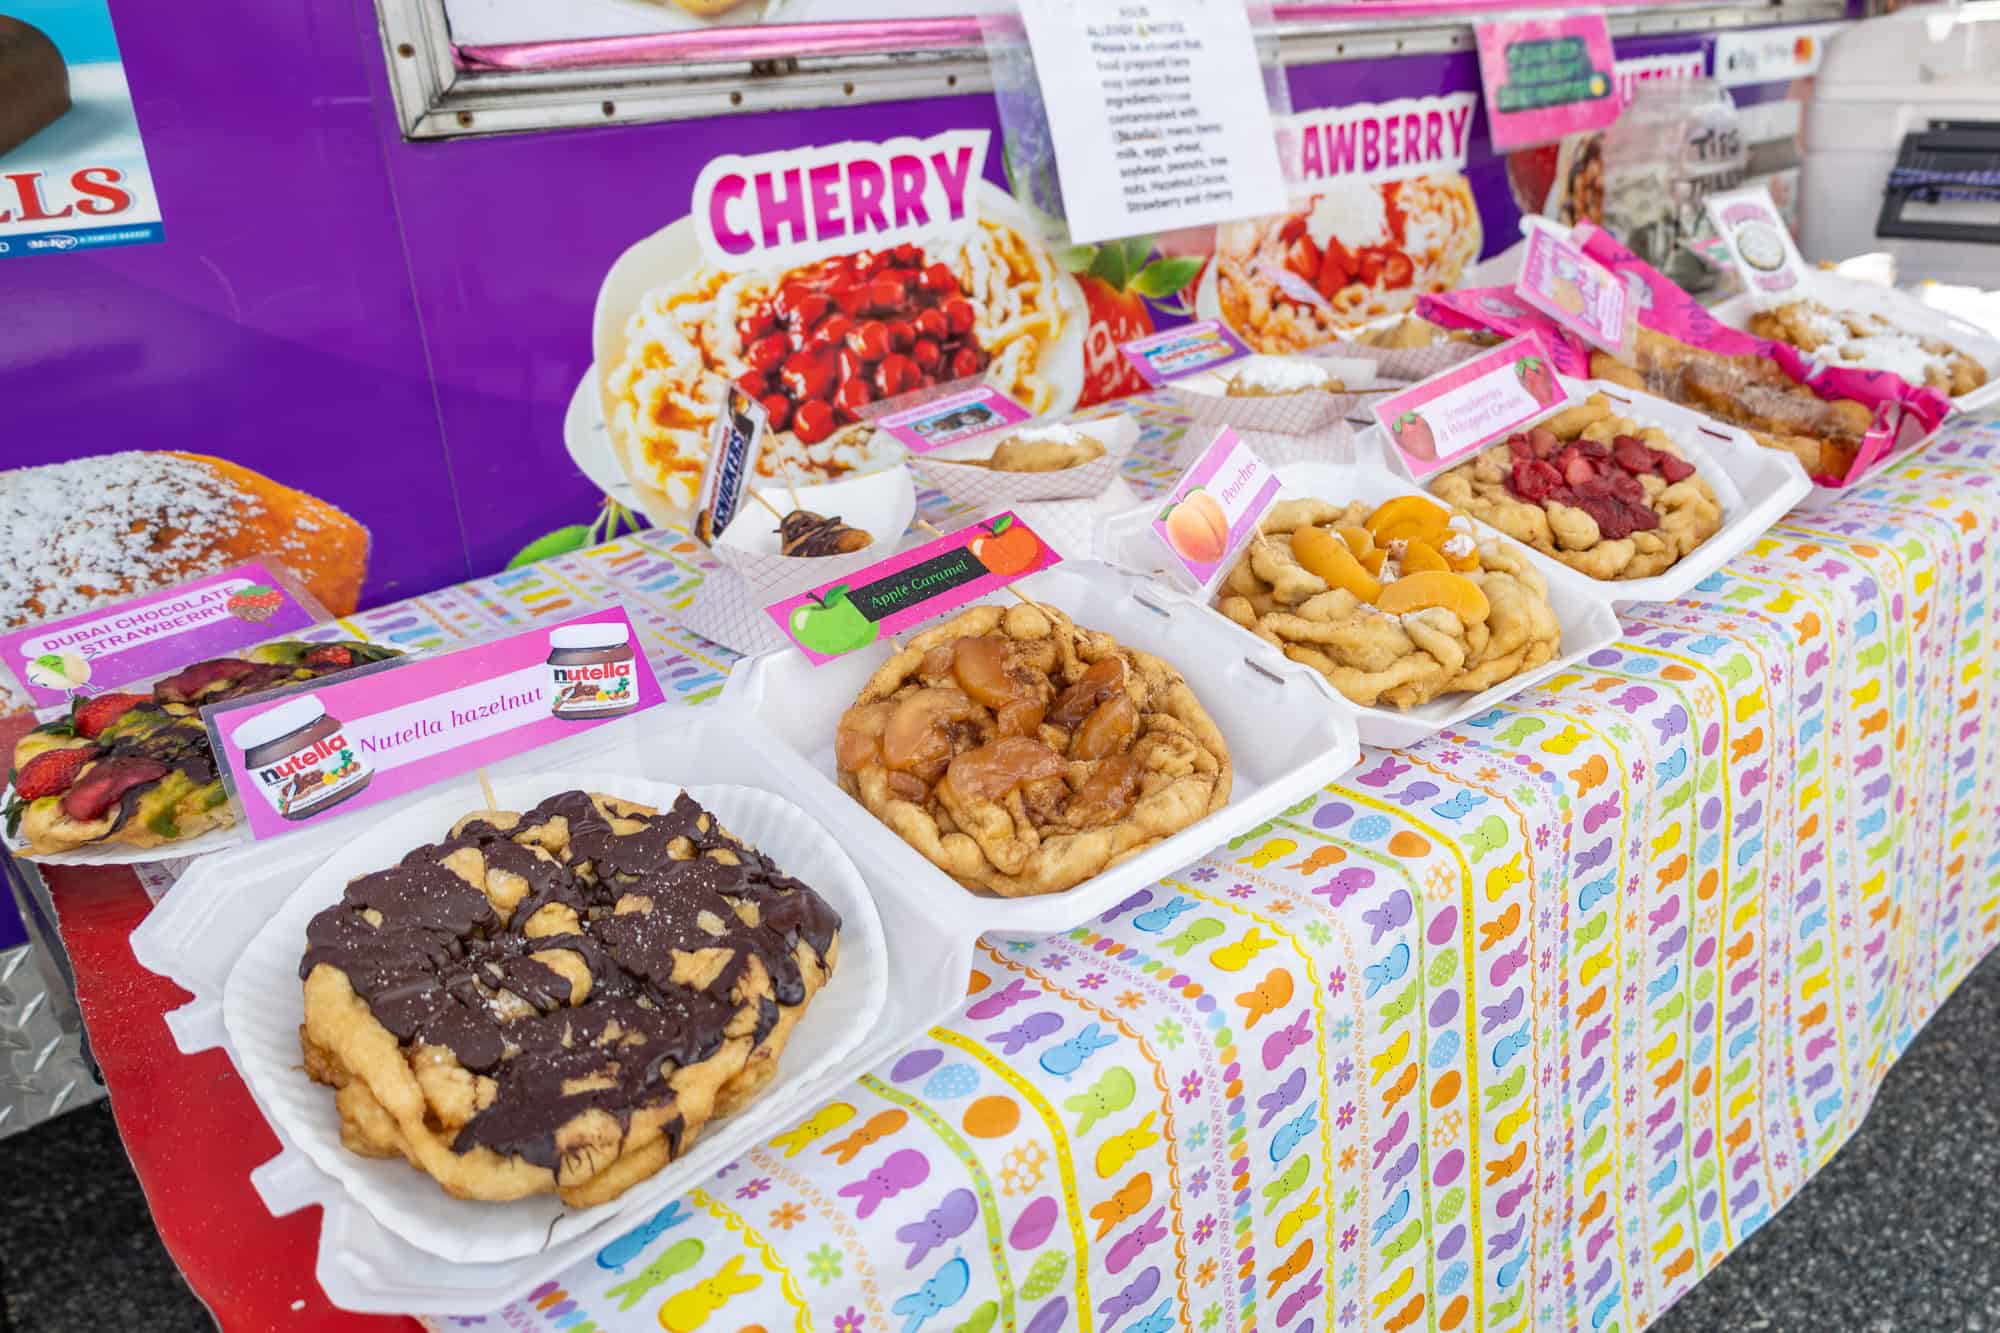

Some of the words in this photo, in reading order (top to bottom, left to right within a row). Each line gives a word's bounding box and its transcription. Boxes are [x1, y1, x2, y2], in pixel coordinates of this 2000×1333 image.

[1102, 80, 1123, 91] may
[1126, 76, 1161, 87] contain
[1164, 74, 1191, 85] these
[1124, 57, 1166, 71] prepared
[1109, 110, 1177, 125] contaminated
[1278, 105, 1469, 182] AWBERRY
[0, 167, 130, 223] LS
[709, 146, 974, 256] CHERRY
[1126, 198, 1181, 214] Strawberry
[1184, 194, 1201, 206] and
[1221, 461, 1257, 505] Peaches
[871, 580, 910, 609] Apple
[911, 558, 969, 591] Caramel
[42, 623, 114, 652] DUBAI
[114, 585, 236, 631] CHOCOLATE
[79, 601, 228, 655] STRAWBERRY
[554, 661, 631, 683] nutella
[359, 717, 444, 754] Nutella
[449, 686, 544, 730] hazelnut
[259, 733, 349, 784] nutella
